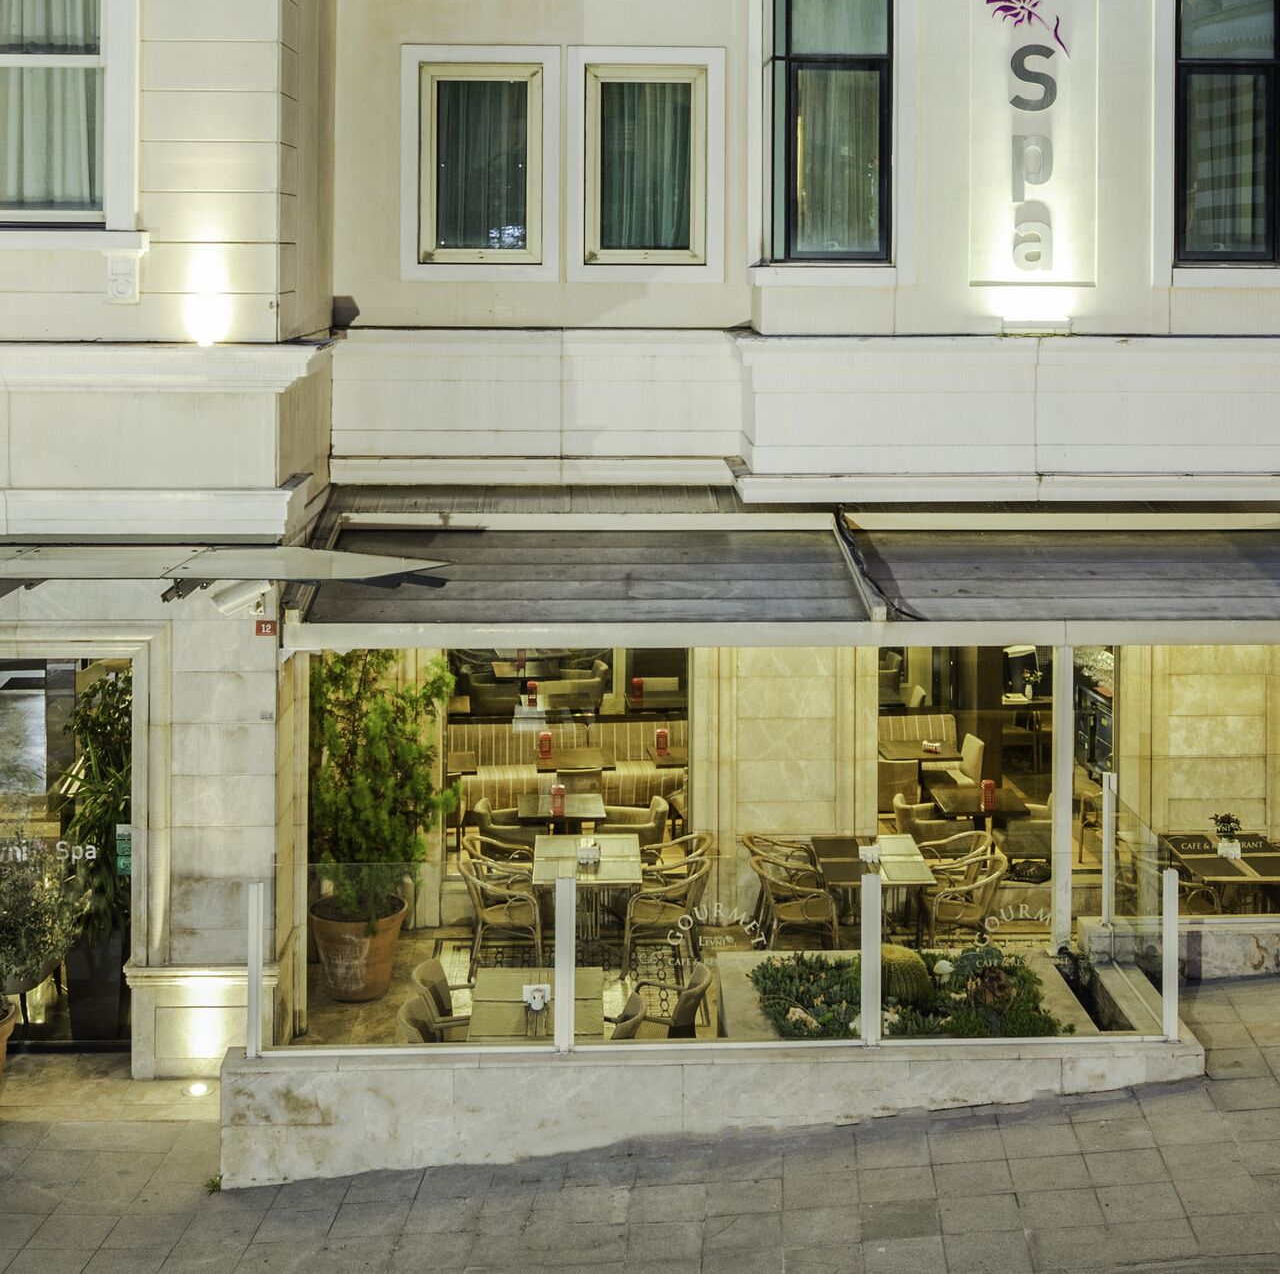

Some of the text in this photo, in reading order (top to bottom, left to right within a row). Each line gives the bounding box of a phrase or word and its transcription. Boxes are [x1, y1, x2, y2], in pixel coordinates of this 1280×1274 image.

[1009, 44, 1058, 271] Spa
[261, 623, 272, 633] 12
[56, 840, 97, 864] Spa
[1181, 842, 1201, 850] CAFE
[667, 902, 768, 946] GOURMET
